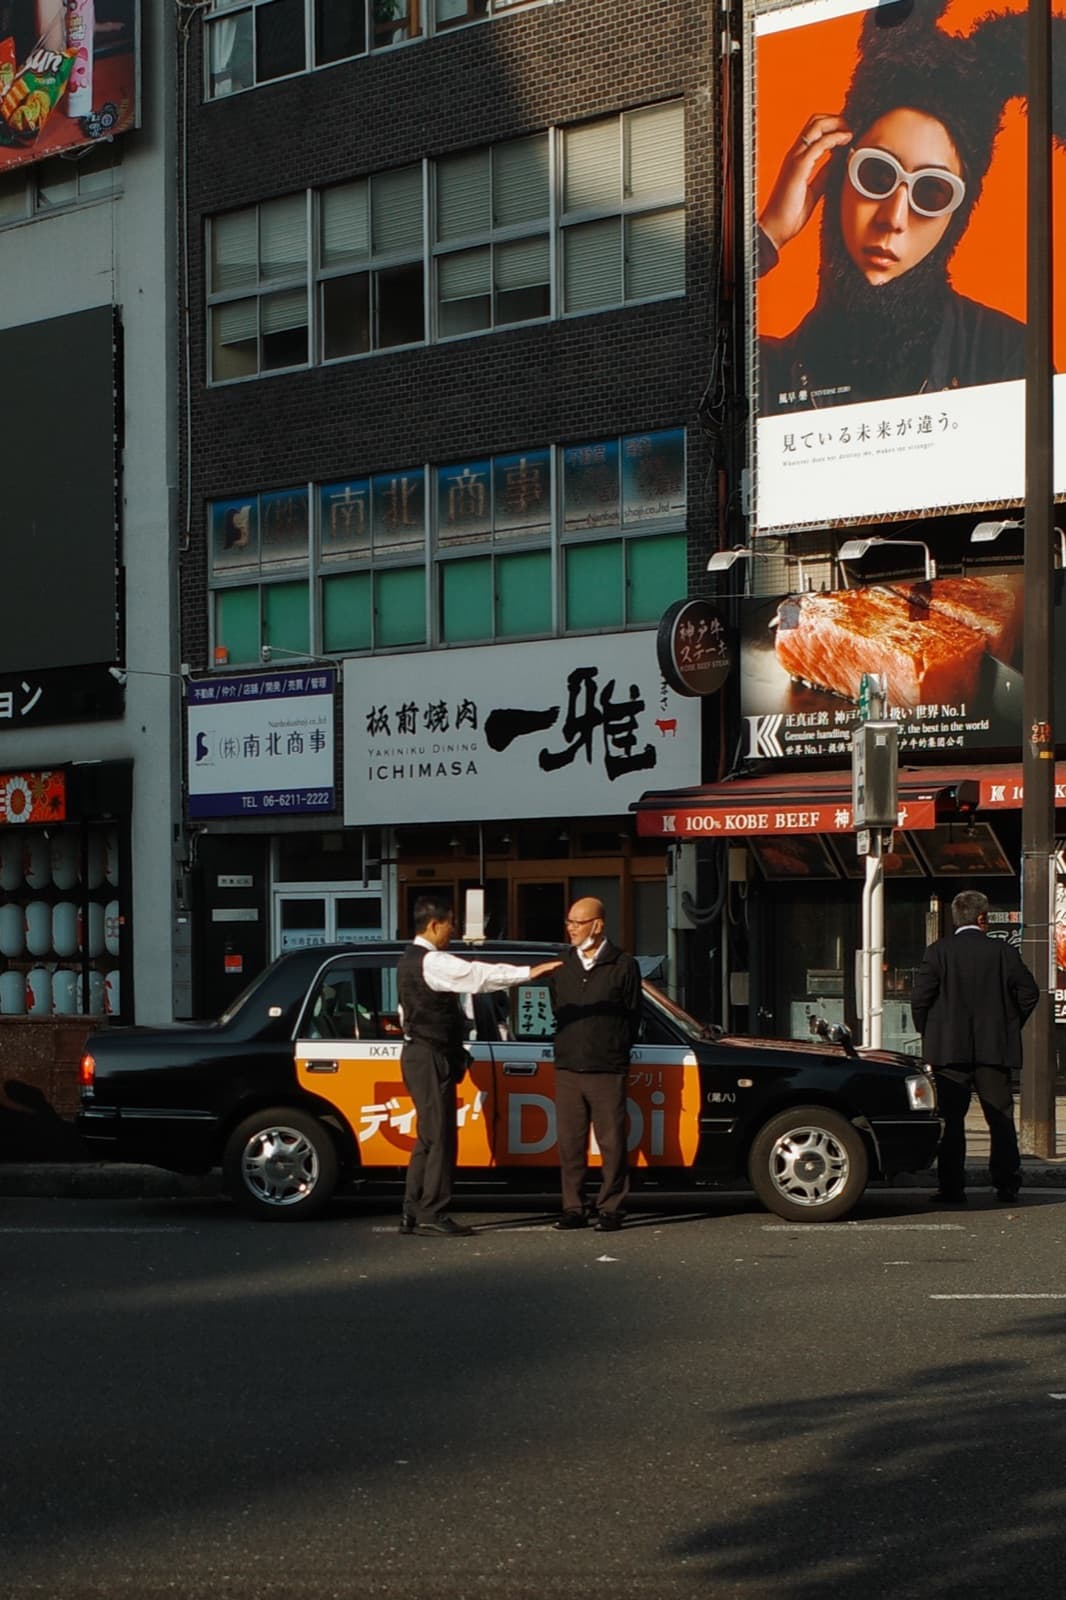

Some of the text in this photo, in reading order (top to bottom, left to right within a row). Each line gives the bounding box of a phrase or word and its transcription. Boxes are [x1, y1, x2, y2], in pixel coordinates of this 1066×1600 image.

[783, 412, 958, 453] 見ている未来が違う。
[366, 699, 478, 737] 板前焼肉
[916, 703, 939, 720] 世界
[941, 703, 966, 718] No.1
[908, 723, 921, 735] the
[922, 722, 939, 733] best
[941, 721, 949, 732] in
[951, 719, 964, 731] the
[965, 719, 990, 731] world
[219, 728, 327, 759] (株)南北商事
[368, 743, 478, 758] YAKINIKU DINING
[369, 760, 478, 781] ICHIMASA
[242, 792, 329, 808] TEL 06-6211-2222
[725, 813, 769, 830] KOBE
[775, 811, 820, 829] BEEF
